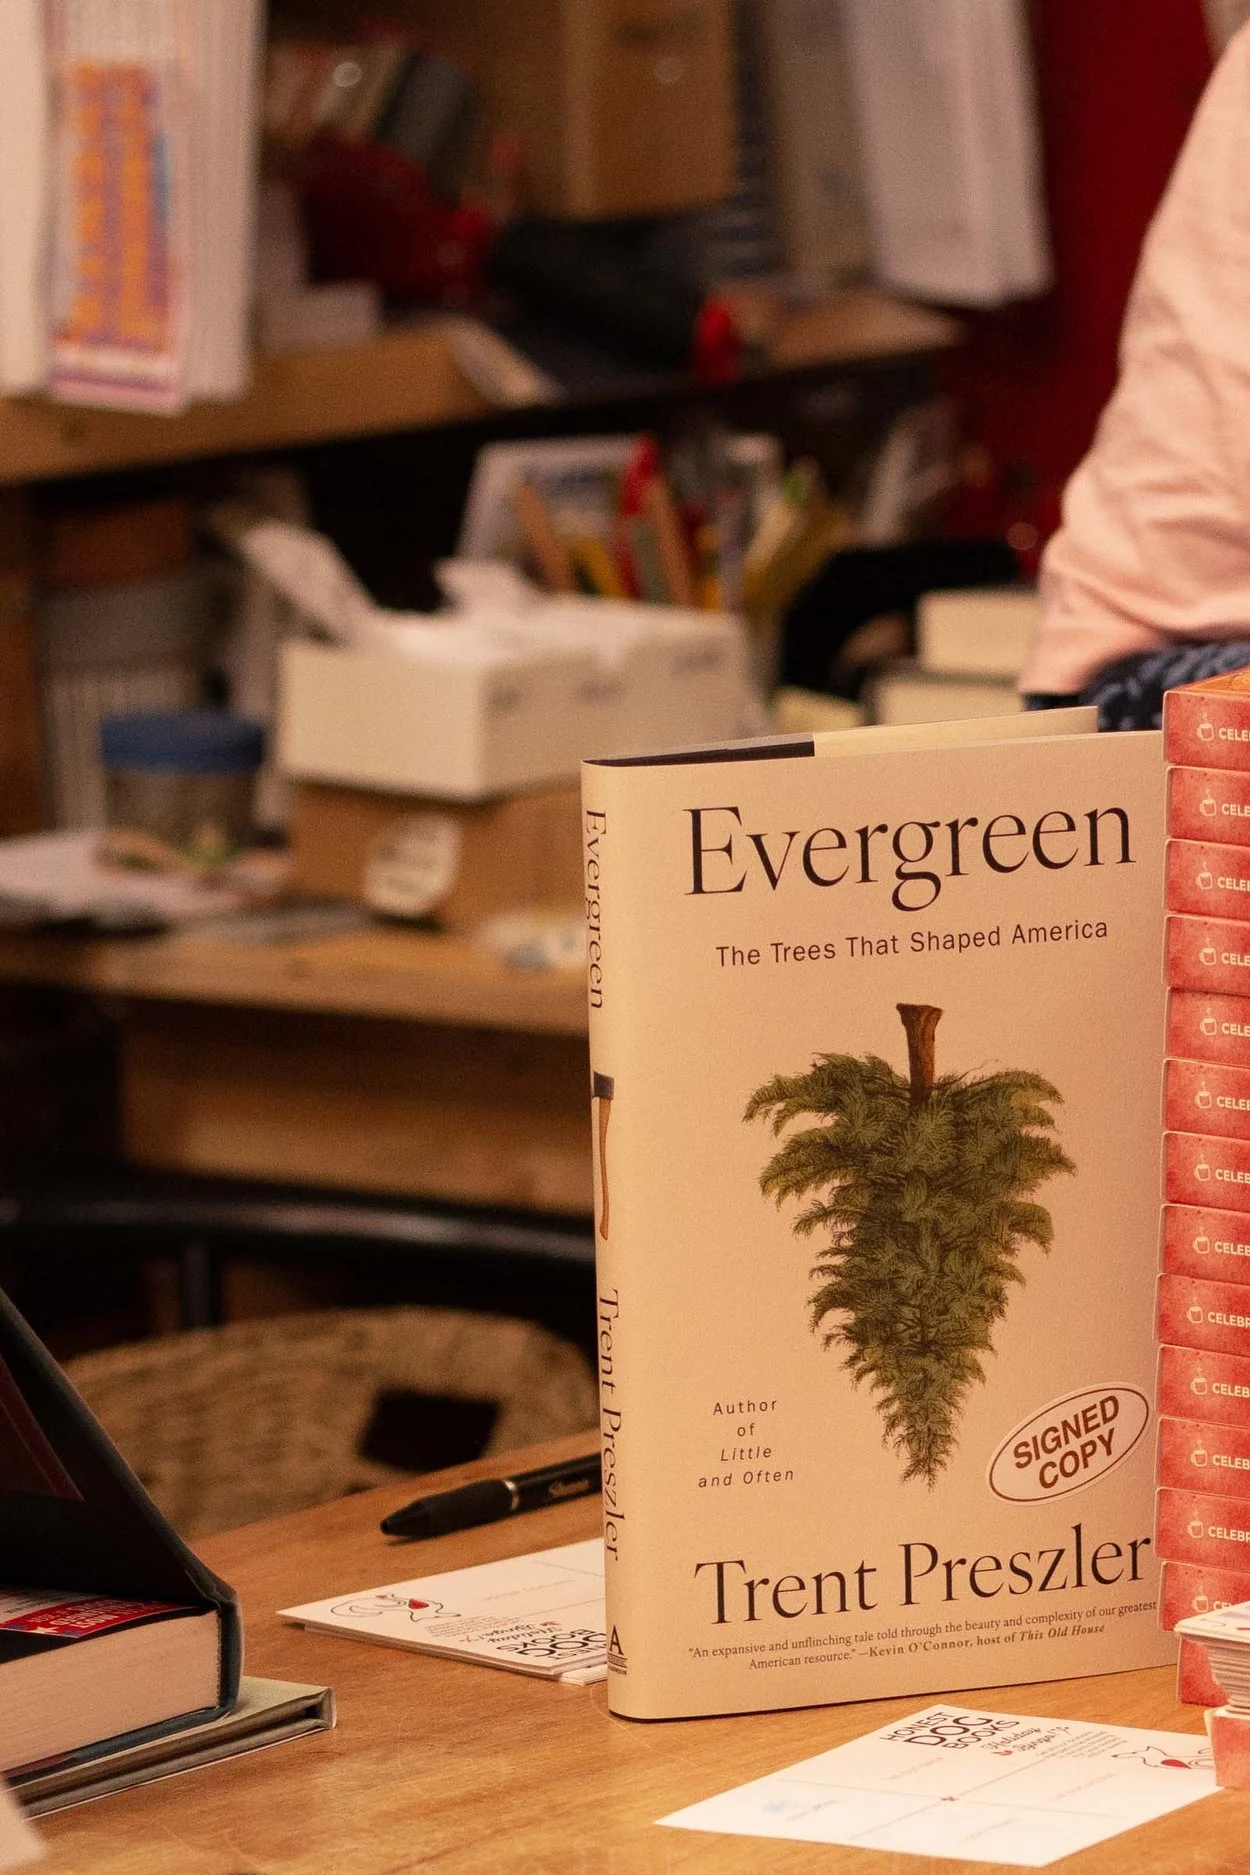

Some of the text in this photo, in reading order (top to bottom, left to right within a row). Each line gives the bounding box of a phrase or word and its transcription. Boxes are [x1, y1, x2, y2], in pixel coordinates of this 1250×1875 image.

[683, 805, 1136, 912] Evergreen
[585, 808, 607, 1010] Evergreen
[716, 920, 1108, 967] The Trees That Shaped America
[599, 1289, 626, 1561] Trent Preszler
[713, 1400, 777, 1415] Author
[737, 1422, 755, 1437] of
[1013, 1395, 1120, 1469] SIGNED
[720, 1446, 772, 1462] Little
[1039, 1427, 1115, 1489] COPY
[698, 1470, 794, 1488] and Often
[694, 1522, 1152, 1624] Trent Preszler
[497, 1628, 597, 1652] BOOKS
[609, 1624, 624, 1656] A
[712, 1644, 767, 1658] expansive
[769, 1639, 789, 1652] and
[791, 1635, 852, 1650] unflinching
[854, 1632, 874, 1643] tale
[877, 1628, 898, 1640] told
[901, 1624, 942, 1638] through
[945, 1621, 963, 1633] the
[965, 1617, 1001, 1633] beauty
[1003, 1615, 1023, 1627] and
[1026, 1609, 1083, 1626] complexity
[1085, 1606, 1097, 1618] of
[1099, 1607, 1115, 1616] our
[1118, 1600, 1157, 1616] greatest
[748, 1656, 801, 1670] American
[976, 1634, 1001, 1647] host
[1004, 1631, 1017, 1644] of
[1019, 1627, 1044, 1642] This
[1047, 1625, 1067, 1639] Old
[1071, 1623, 1105, 1636] House
[880, 1711, 954, 1742] HONEST
[903, 1716, 993, 1746] DOG
[942, 1719, 1020, 1750] BOOKS
